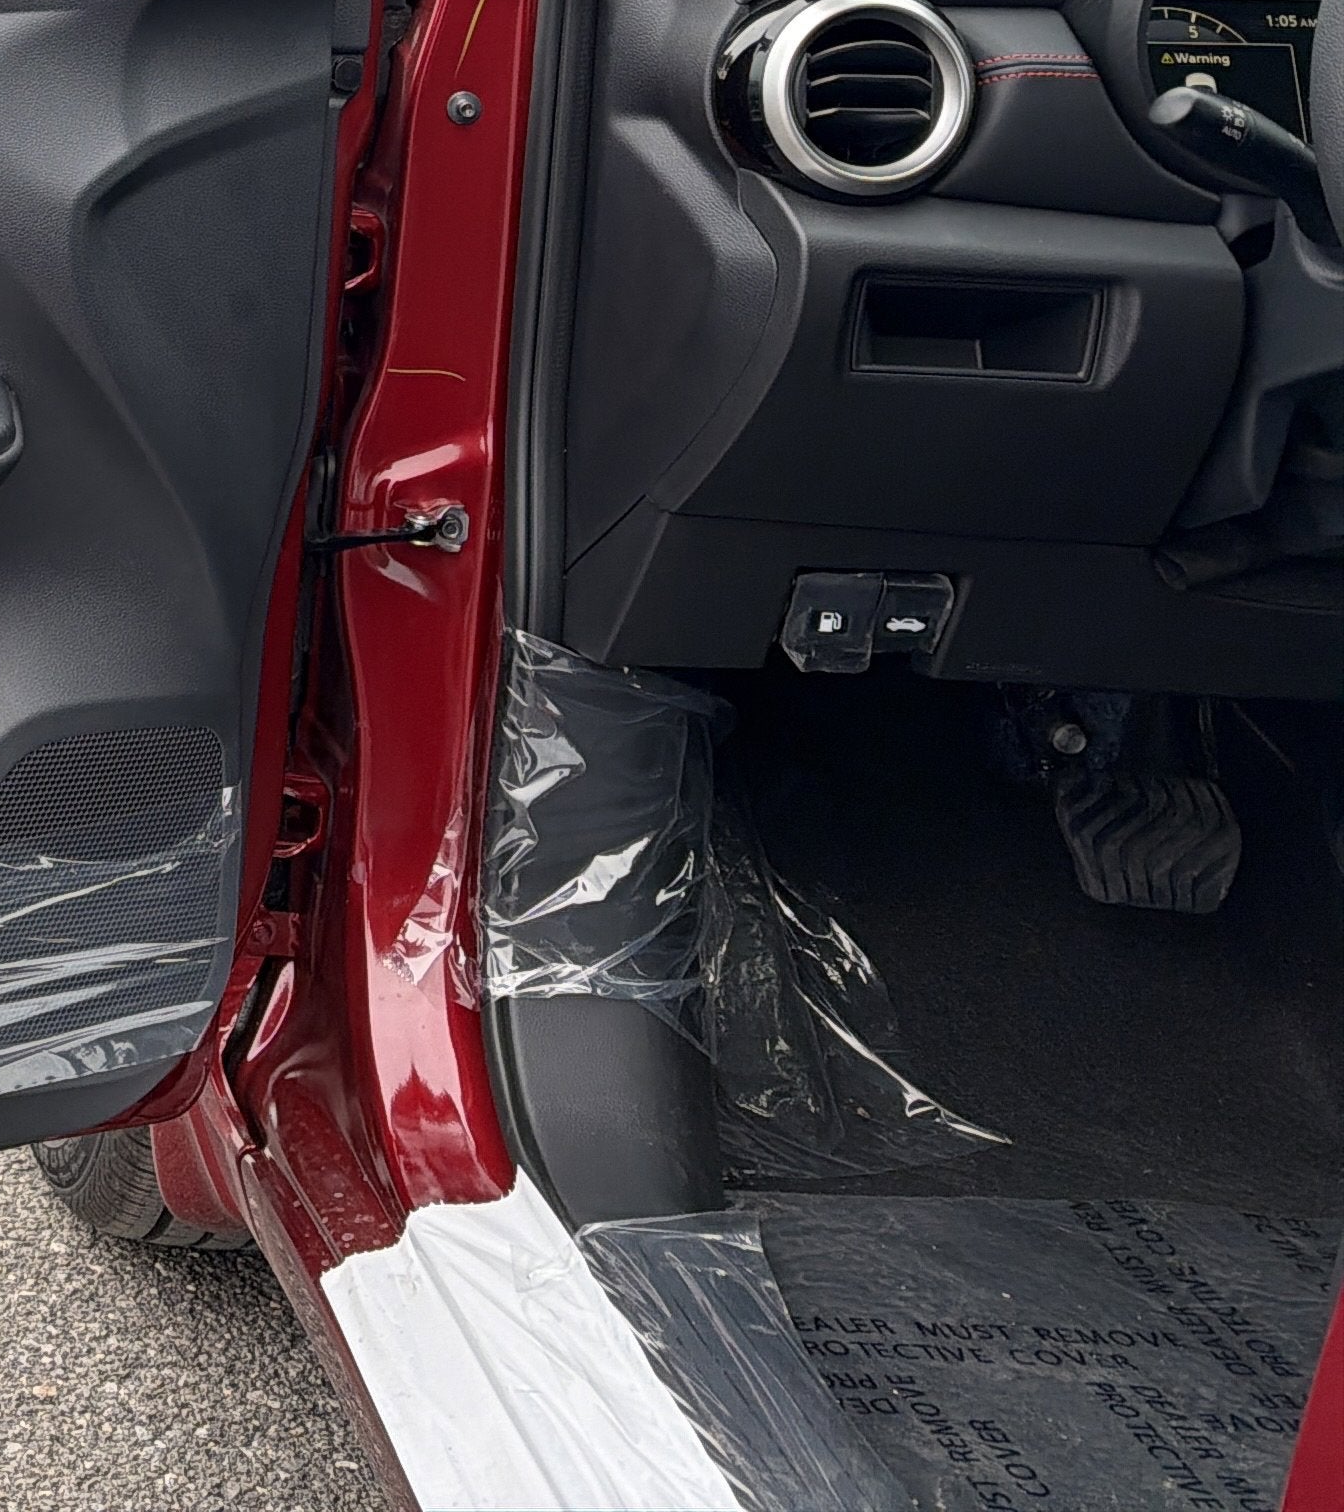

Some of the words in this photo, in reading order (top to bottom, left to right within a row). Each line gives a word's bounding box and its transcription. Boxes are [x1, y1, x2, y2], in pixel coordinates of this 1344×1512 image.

[1188, 25, 1199, 39] 5
[1265, 14, 1298, 28] 1:05
[1174, 52, 1231, 67] Warning
[915, 1321, 1012, 1340] MUST
[1031, 1325, 1190, 1351] REMOVE
[1167, 1305, 1258, 1377] DEALER
[1009, 1348, 1140, 1372] COVER
[1129, 1384, 1226, 1460] DEALER
[967, 1418, 1051, 1499] COVER
[1085, 1381, 1226, 1511] PROTECTIVE
